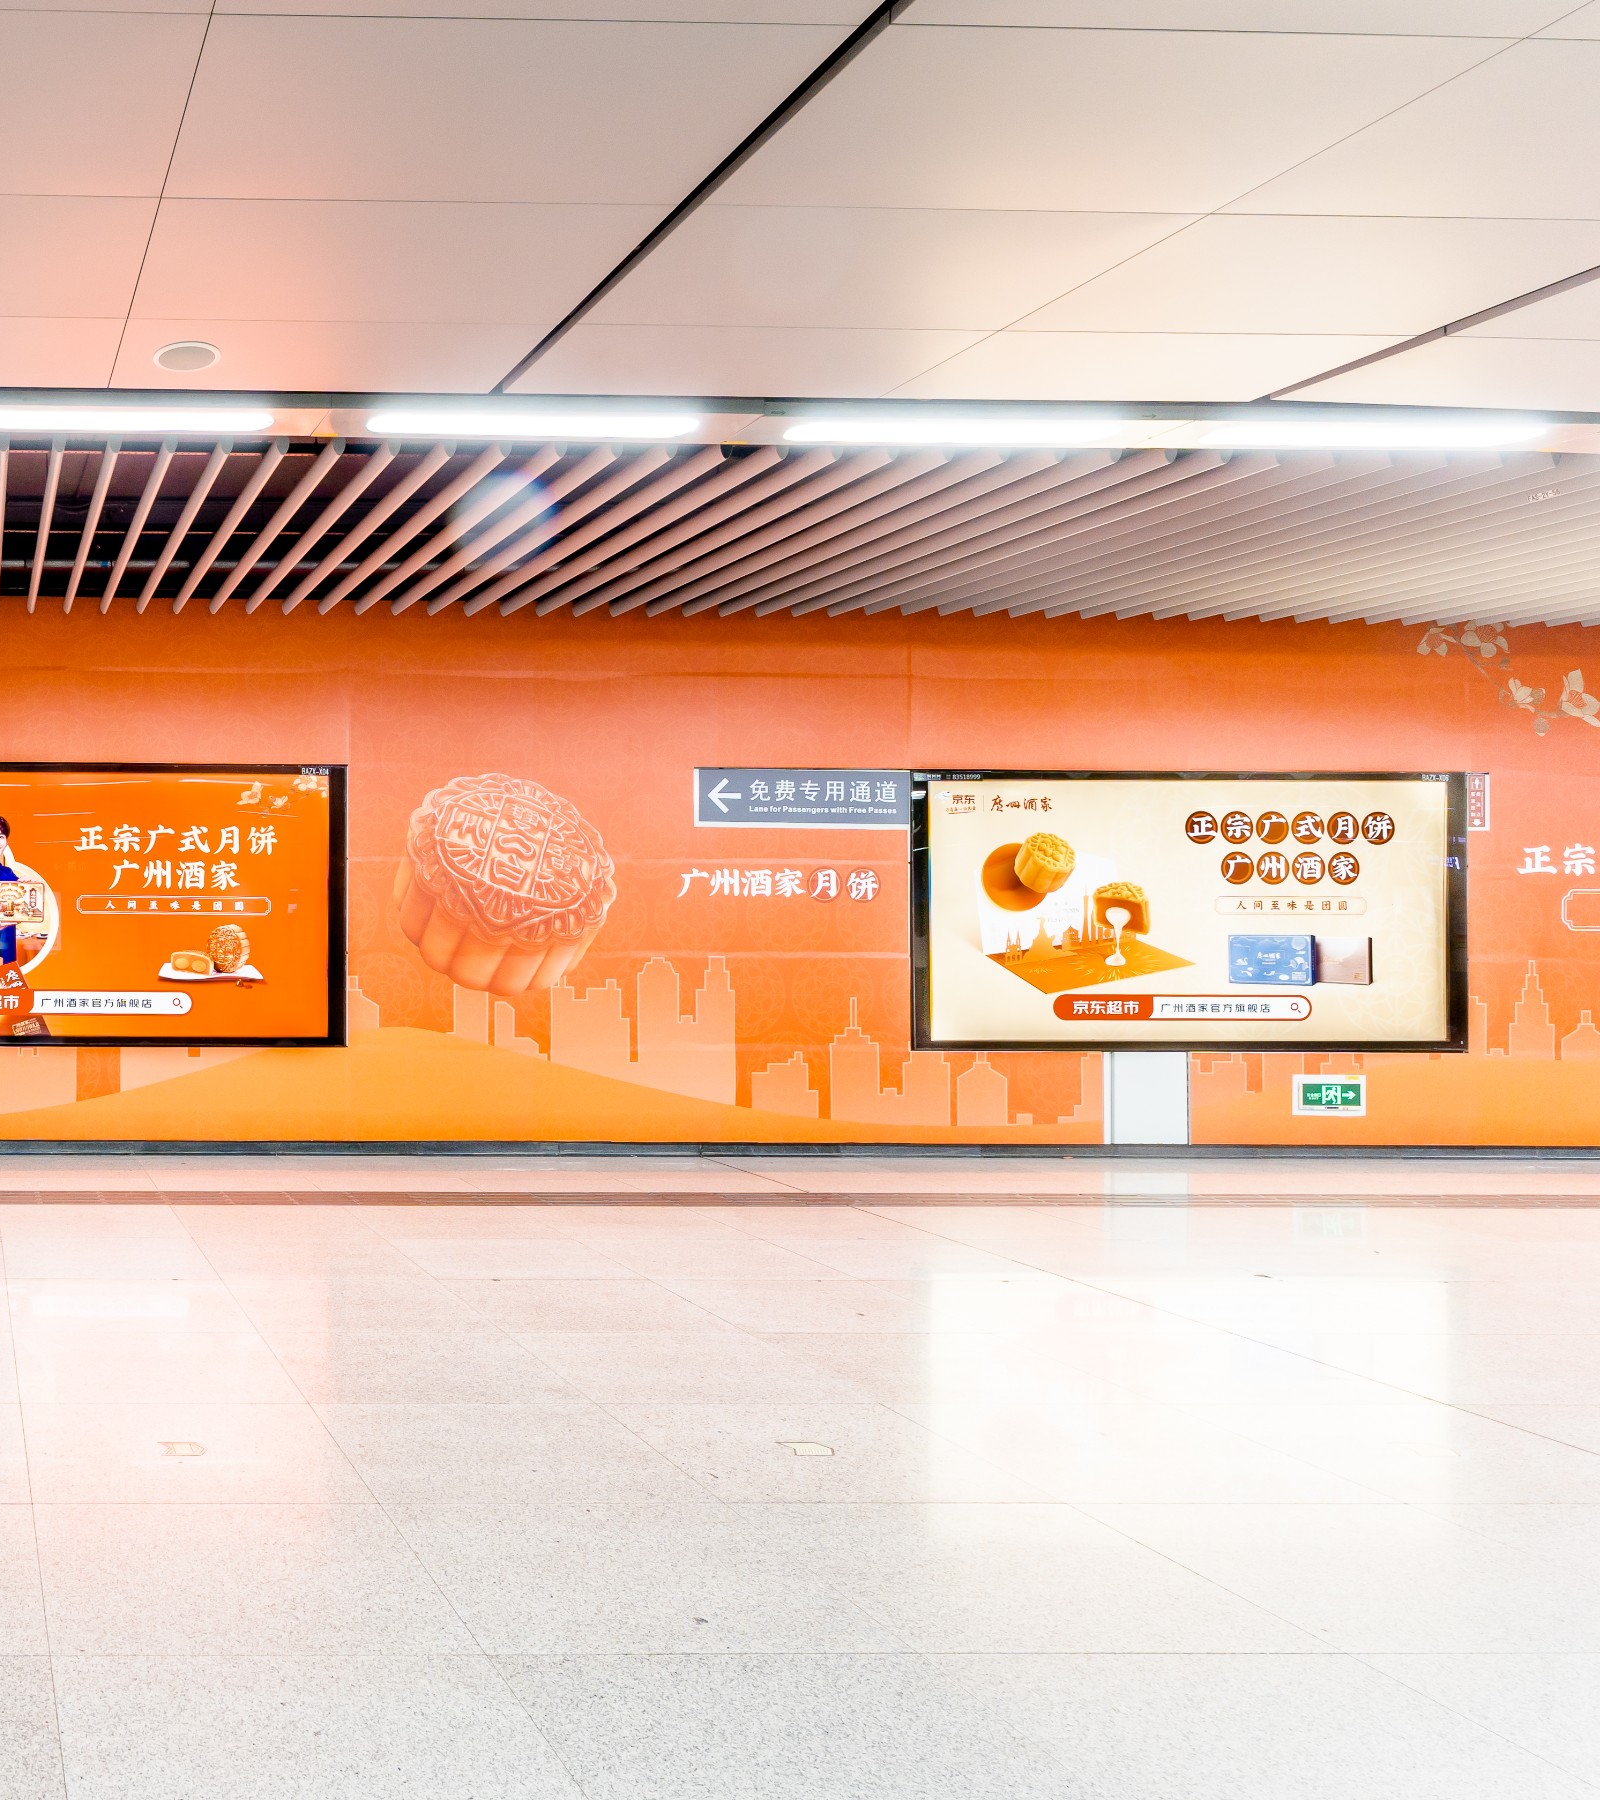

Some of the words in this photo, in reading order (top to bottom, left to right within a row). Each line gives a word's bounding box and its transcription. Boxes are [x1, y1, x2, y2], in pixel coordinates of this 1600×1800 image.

[749, 778, 898, 803] 免费专用通道
[952, 794, 976, 805] 京东
[782, 806, 829, 815] Passengers
[849, 806, 866, 814] Free
[73, 823, 278, 855] 正宗广式月饼
[1186, 813, 1395, 841] 正宗广式月饼
[1223, 854, 1359, 881] 广州酒家
[1516, 843, 1596, 877] 正宗
[108, 859, 241, 890] 广州酒家
[677, 867, 880, 901] 广州酒家月饼
[104, 899, 244, 911] 人间至味是团圆
[1235, 900, 1349, 911] 人间至味是团圆
[40, 998, 153, 1009] 广州酒家官方旗舰店
[1072, 1000, 1140, 1015] 京东超市
[1160, 1003, 1271, 1014] 广州酒家官方旗舰店
